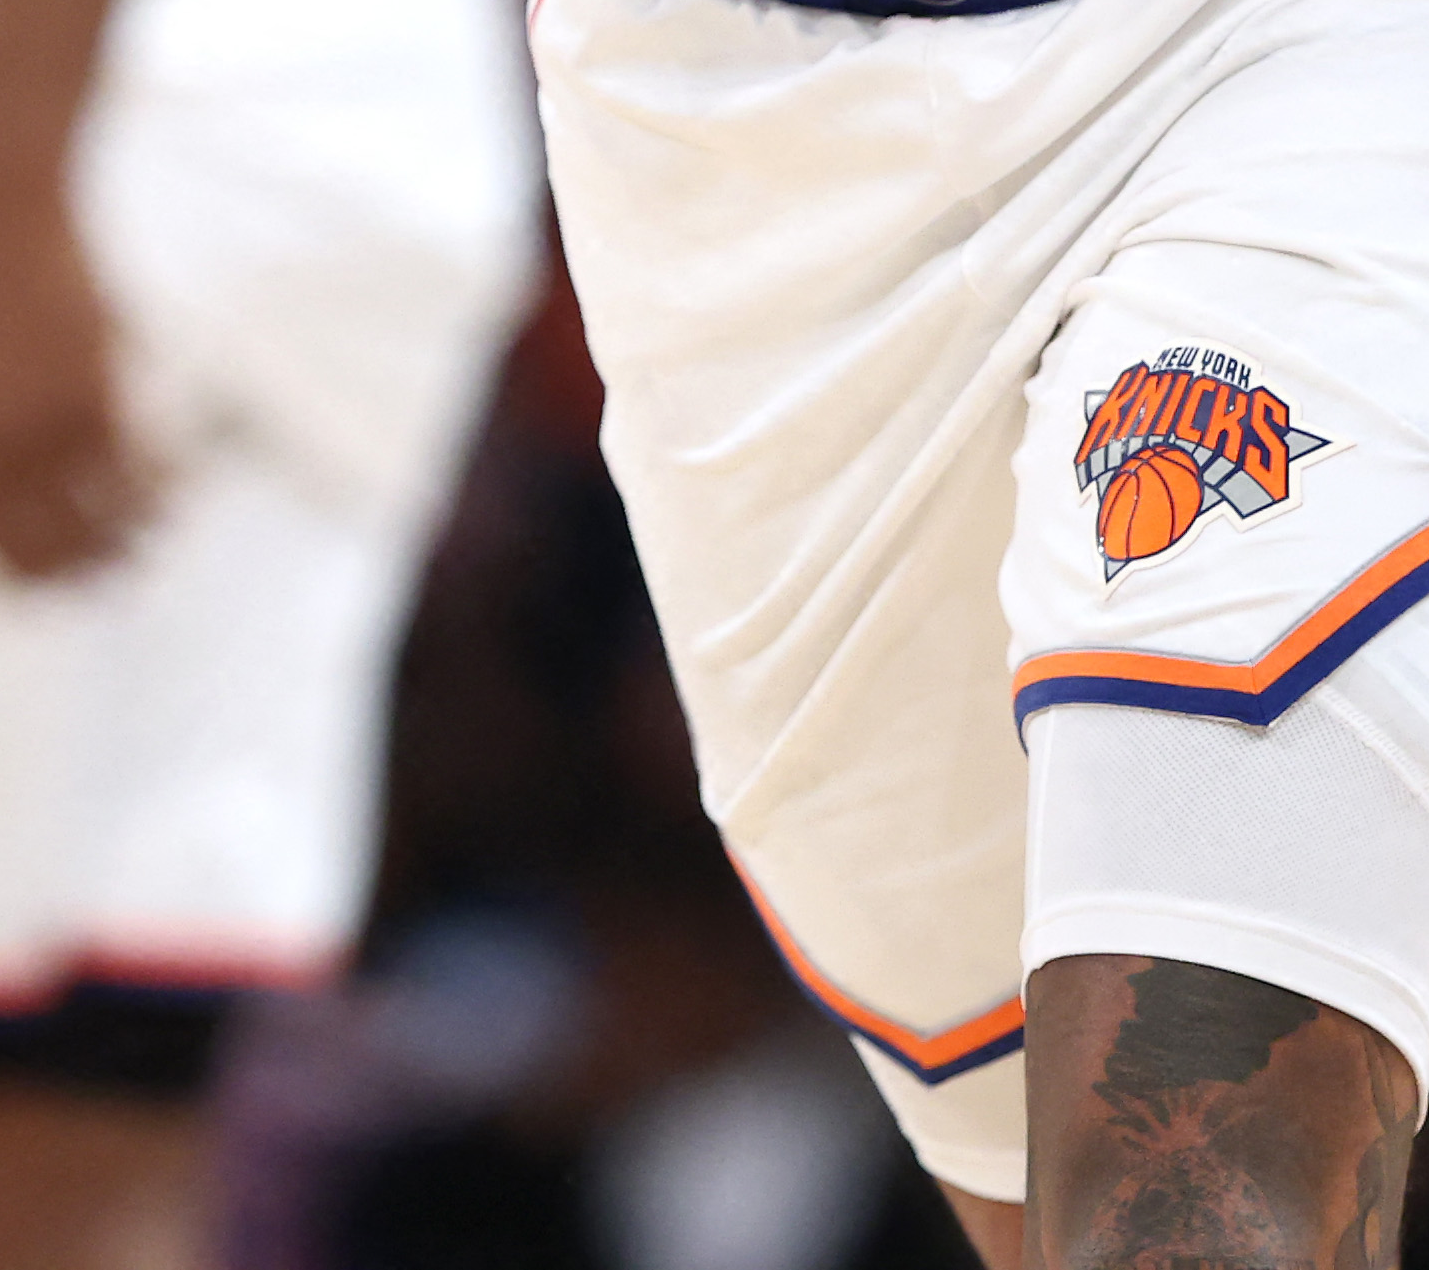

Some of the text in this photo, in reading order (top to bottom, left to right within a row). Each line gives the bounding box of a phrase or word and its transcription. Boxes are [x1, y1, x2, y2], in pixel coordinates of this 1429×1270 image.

[1153, 346, 1252, 389] NEW YORK
[1075, 360, 1290, 503] KNICKS
